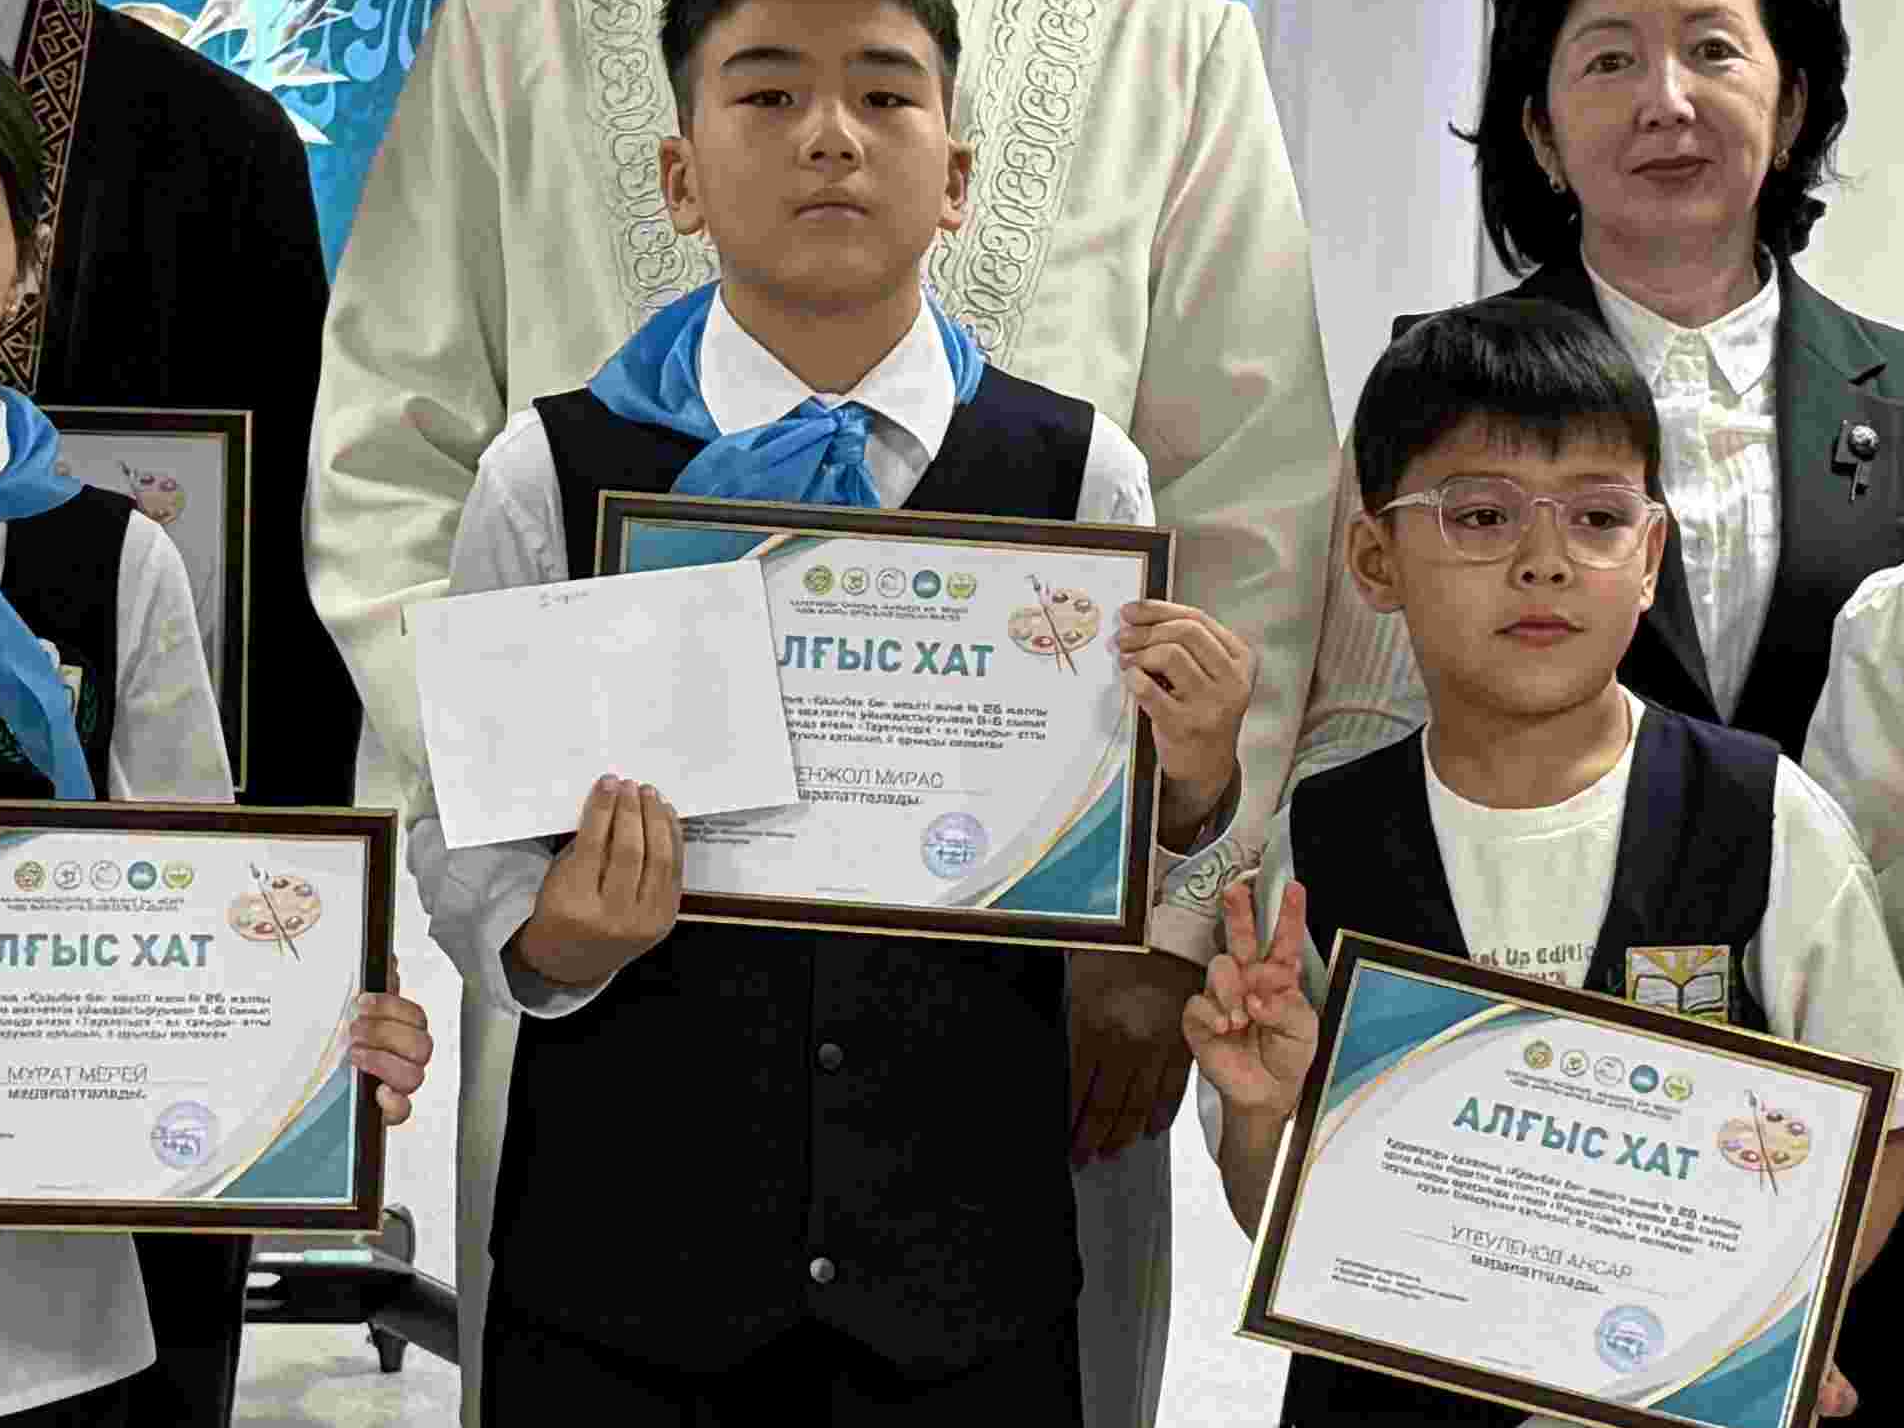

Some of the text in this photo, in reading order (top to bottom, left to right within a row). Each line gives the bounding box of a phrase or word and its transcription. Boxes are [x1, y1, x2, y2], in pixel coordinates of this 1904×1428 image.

[776, 636, 994, 677] ЛҒЫС ХАТ
[132, 933, 214, 967] ХАТ
[1536, 942, 1595, 965] Editio
[1453, 1096, 1699, 1181] АЛҒЫС ХАТ
